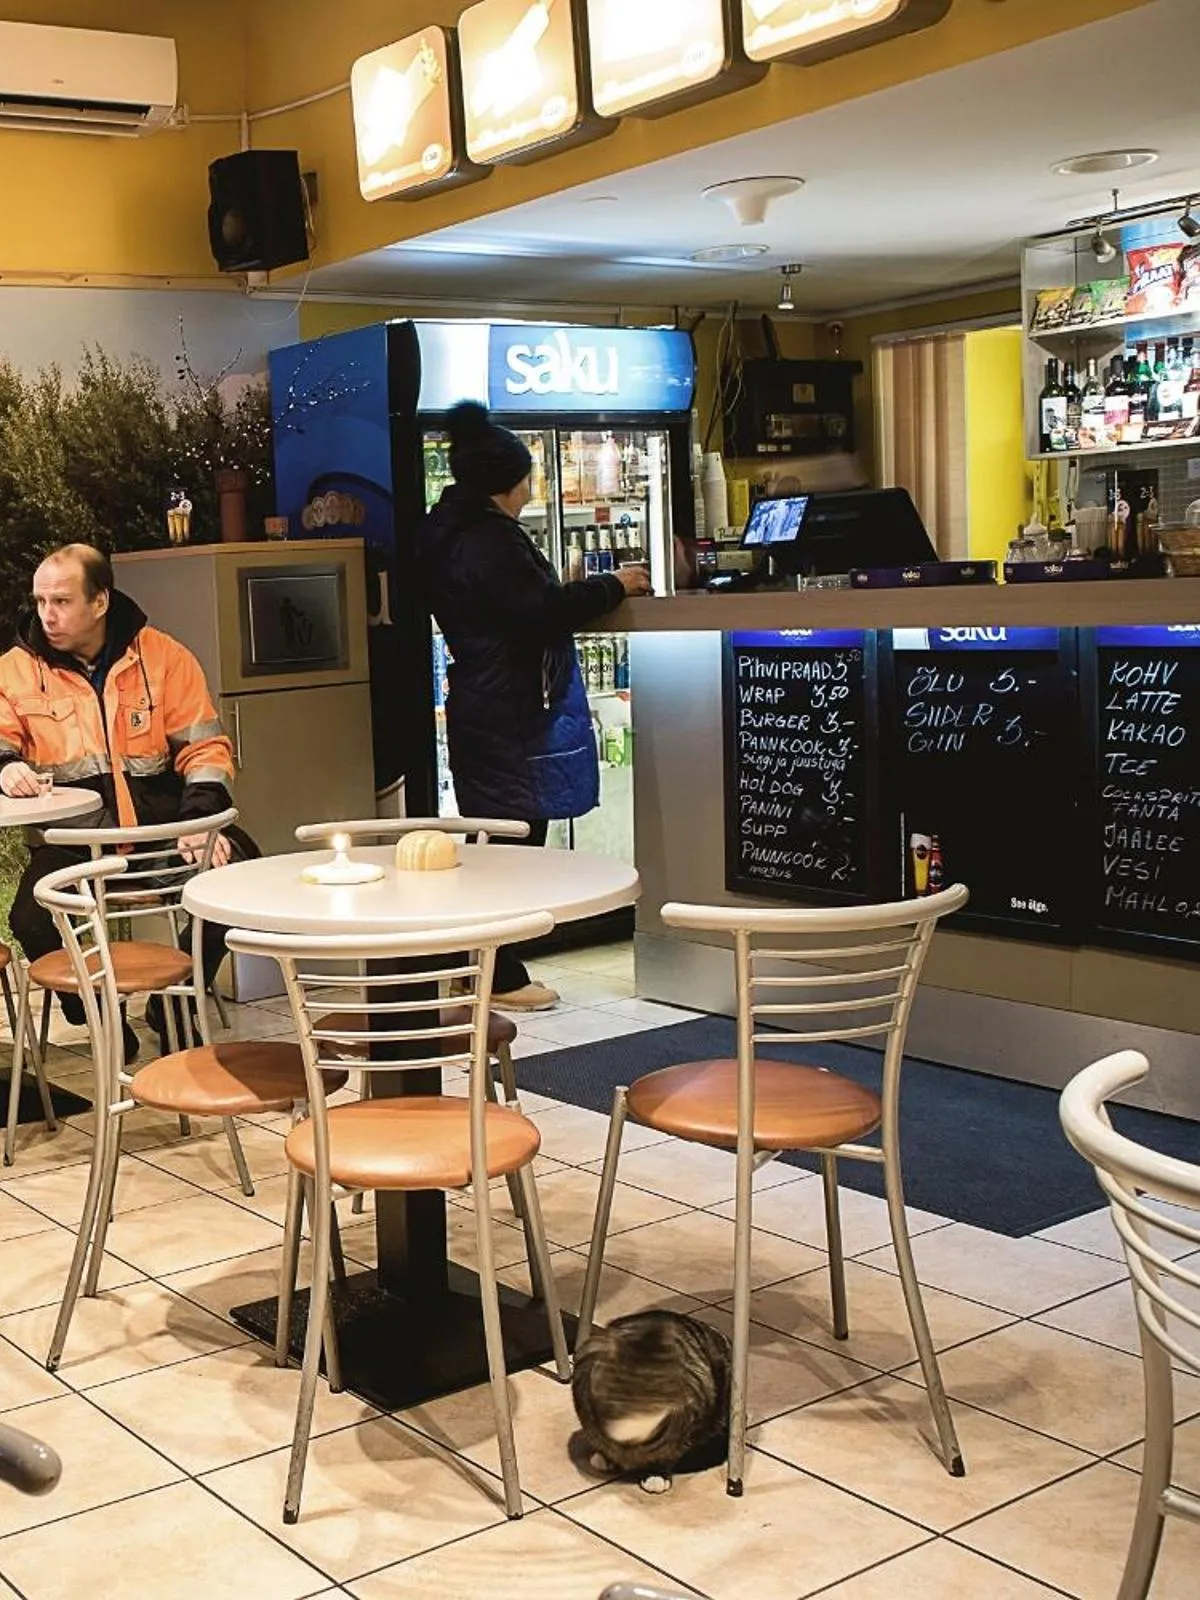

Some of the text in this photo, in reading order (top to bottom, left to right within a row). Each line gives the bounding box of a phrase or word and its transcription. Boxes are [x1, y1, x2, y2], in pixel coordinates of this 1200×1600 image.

[505, 329, 619, 395] saku
[908, 666, 964, 696] ÕLU
[1109, 660, 1179, 687] KOHV
[739, 684, 786, 704] WRAP
[1105, 690, 1182, 715] LATTE
[740, 708, 810, 731] BURGER
[739, 731, 826, 755] PANNKOOK
[1107, 718, 1186, 747] KAKAO
[1105, 753, 1158, 775] TEE
[769, 780, 803, 796] DOG
[1111, 803, 1179, 820] FANTA
[741, 841, 827, 869] PANNKOOK
[1105, 886, 1168, 912] MAHL
